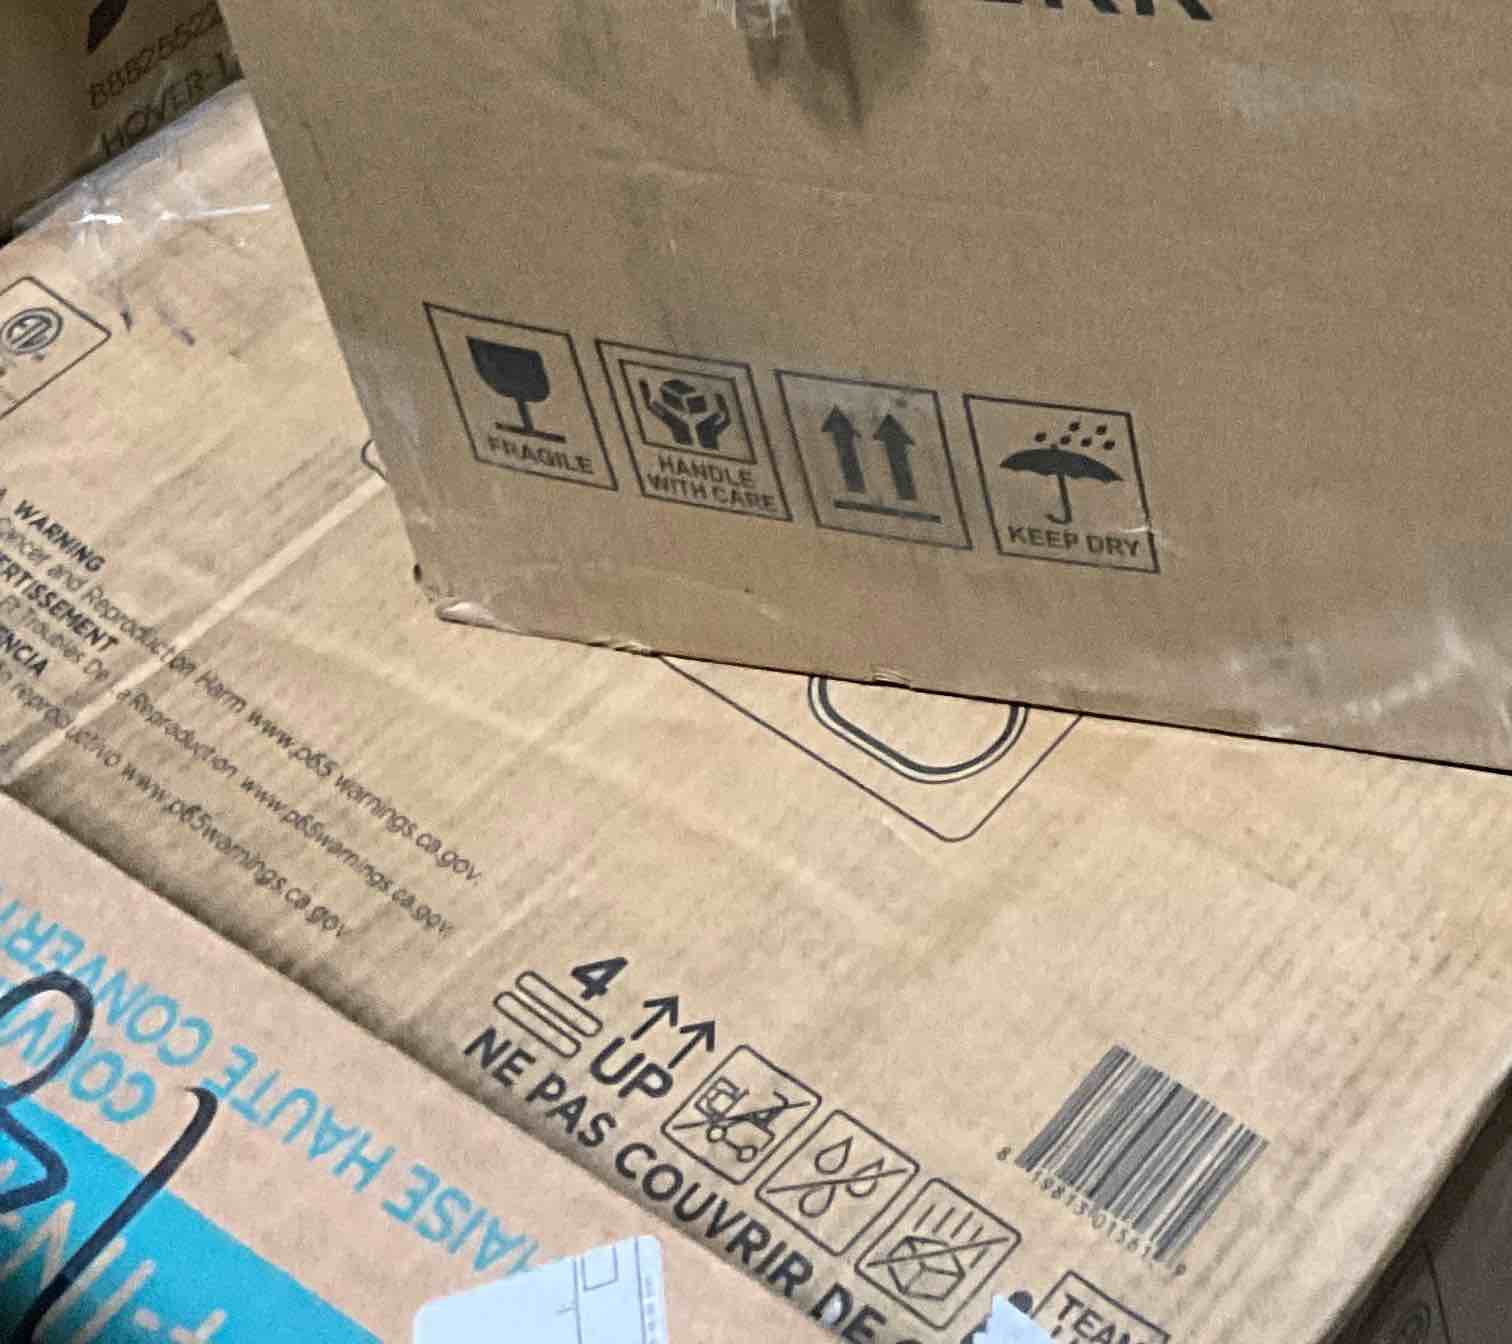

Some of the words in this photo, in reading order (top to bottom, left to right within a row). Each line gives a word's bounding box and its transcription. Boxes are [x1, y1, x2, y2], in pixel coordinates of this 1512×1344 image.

[484, 435, 596, 476] FRAGILE
[657, 454, 755, 489] HANDLE
[647, 472, 711, 503] WITH
[713, 481, 777, 513] CARE
[14, 500, 105, 572] WARNING
[1007, 524, 1079, 552] KEEP
[1086, 534, 1141, 559] DRY
[571, 957, 628, 999] 4
[591, 1036, 674, 1100] UP
[202, 1043, 396, 1193] HAUTE
[463, 1027, 536, 1086] NE
[525, 1071, 618, 1148] PAS
[614, 1142, 814, 1297] COUVRIR
[810, 1282, 887, 1344] DE
